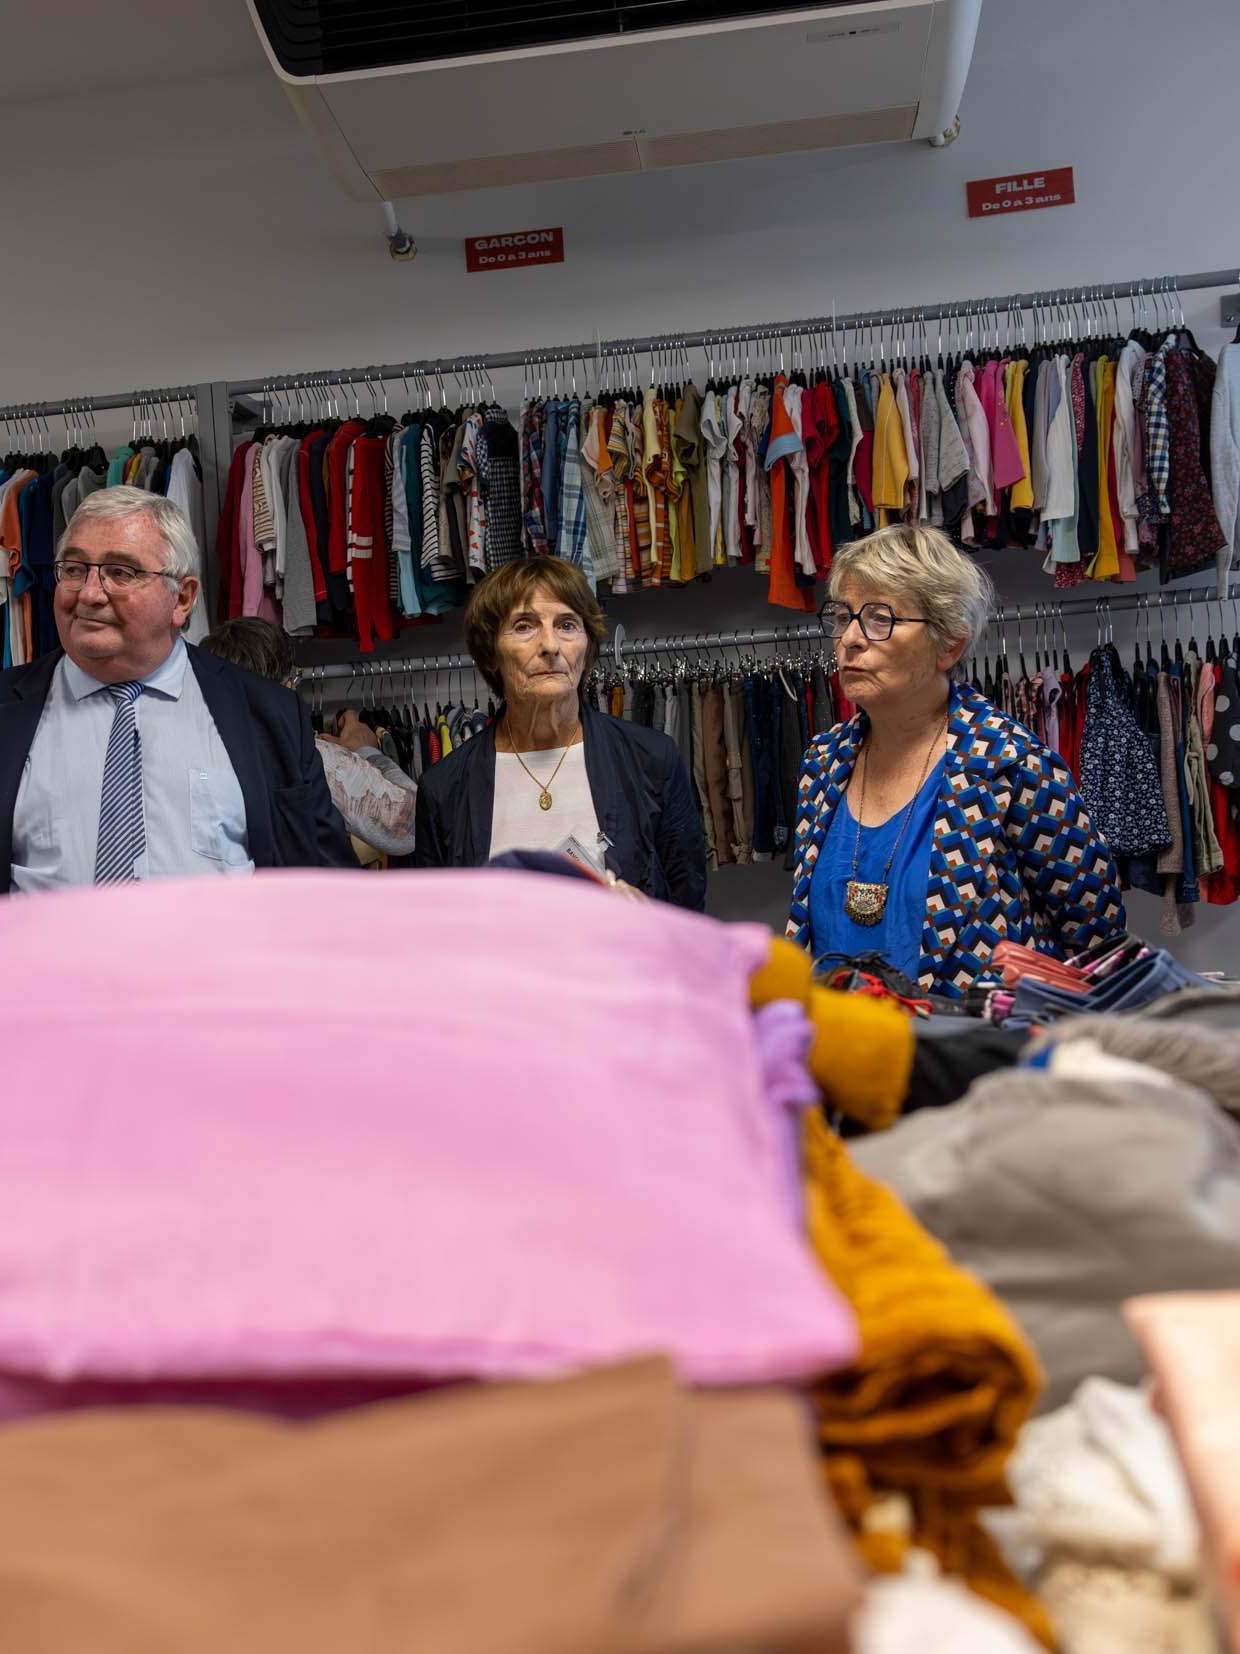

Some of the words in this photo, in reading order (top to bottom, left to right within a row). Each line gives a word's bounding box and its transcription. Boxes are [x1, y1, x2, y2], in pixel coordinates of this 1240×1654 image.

[995, 177, 1046, 194] FILLE
[982, 202, 1000, 211] De
[1001, 199, 1012, 208] 0
[1024, 196, 1034, 205] 3
[1034, 193, 1062, 203] ans
[479, 255, 496, 264] De
[497, 253, 506, 262] 0
[518, 251, 526, 259] 3
[527, 249, 552, 258] ans
